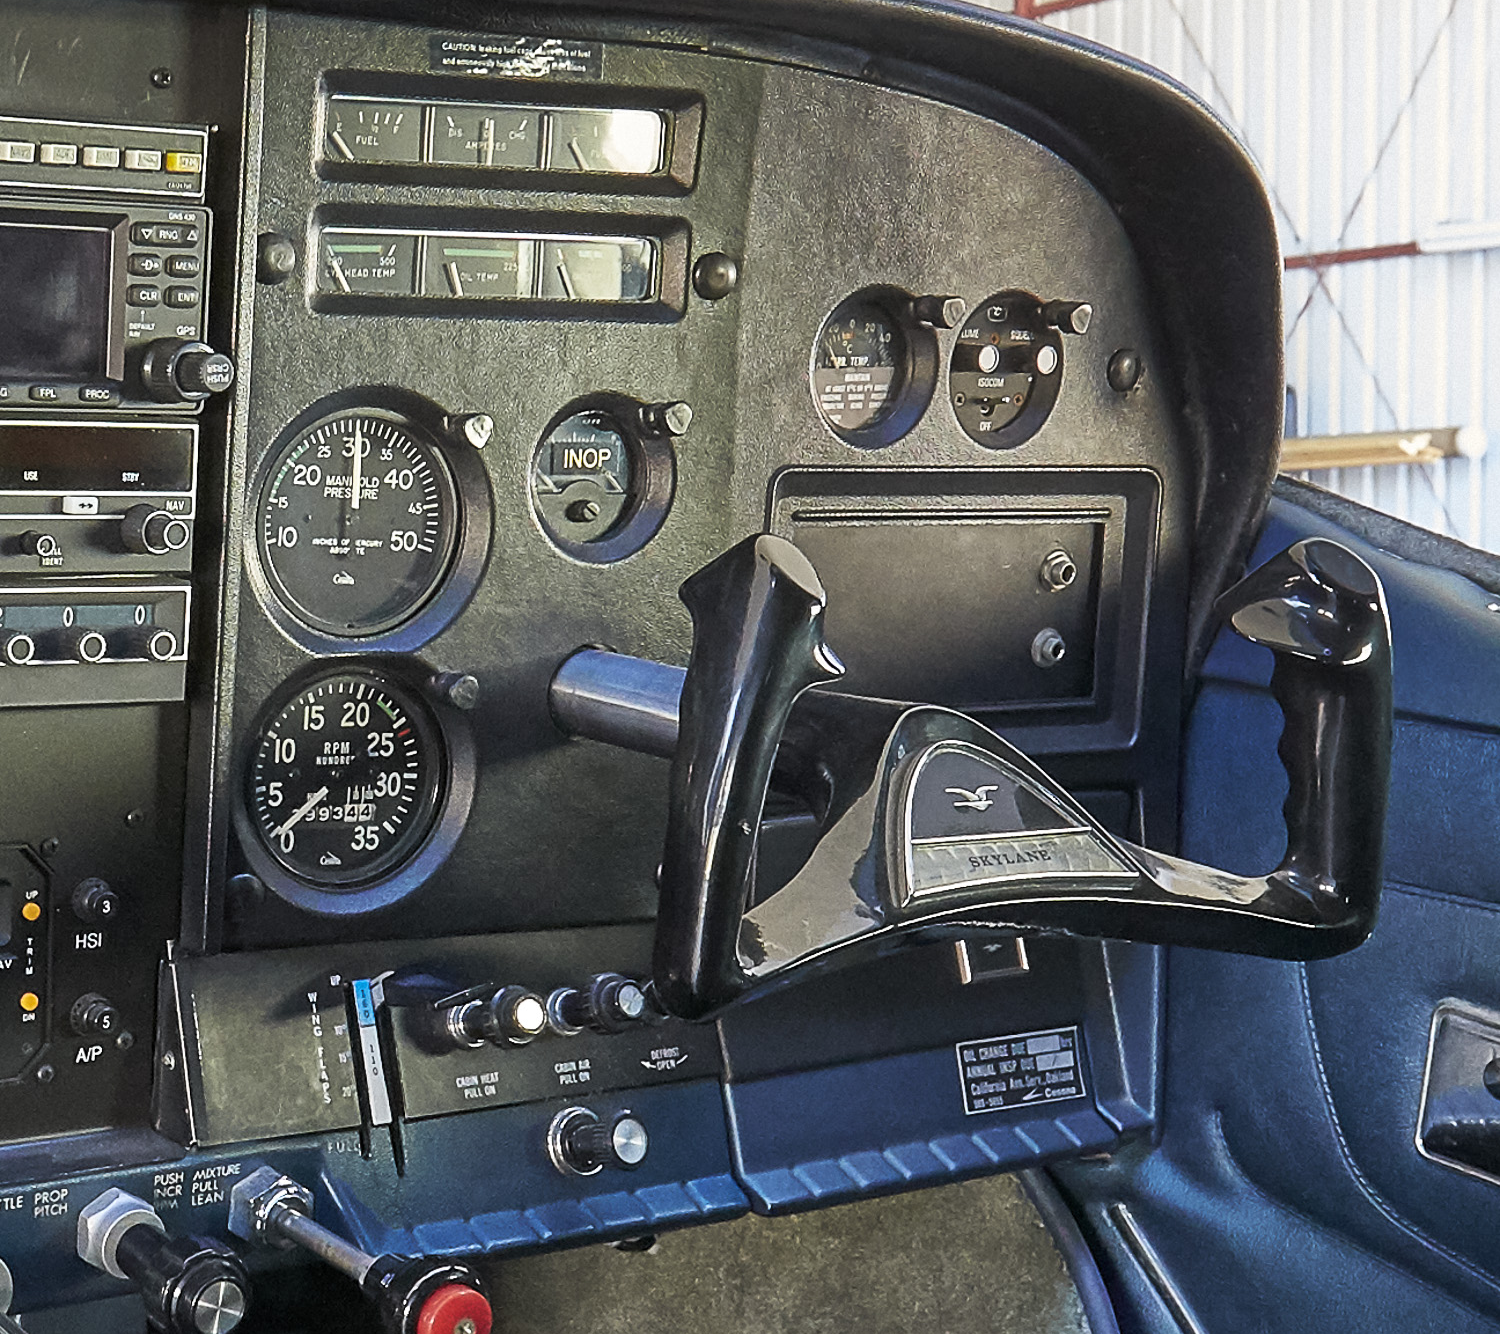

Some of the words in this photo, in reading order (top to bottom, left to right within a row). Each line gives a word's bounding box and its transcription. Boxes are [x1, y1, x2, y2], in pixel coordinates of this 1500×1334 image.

[355, 135, 379, 146] FUEL
[344, 267, 369, 278] HEAD
[371, 268, 396, 279] TEMP
[978, 377, 1004, 388] ISOCOM
[40, 388, 57, 398] FPL
[85, 389, 110, 399] PROC
[980, 421, 992, 432] OFF
[563, 448, 612, 469] INOP
[166, 500, 185, 511] NAV
[324, 742, 350, 754] RPM
[351, 825, 380, 851] 35
[968, 848, 1051, 871] SKYLANE
[75, 934, 102, 950] HSI
[75, 1046, 102, 1063] A/P
[308, 992, 323, 1037] WING
[317, 1046, 332, 1104] FLAPS
[651, 1047, 679, 1060] DEFROST
[963, 1049, 976, 1062] OIL
[978, 1044, 1008, 1060] CHANGE
[554, 1061, 577, 1074] CABIN
[578, 1059, 590, 1070] AIR
[967, 1064, 996, 1078] ANNUAL
[999, 1059, 1017, 1073] INSP
[456, 1076, 479, 1089] CABIN
[480, 1072, 499, 1083] HEAT
[580, 1072, 590, 1082] ON
[464, 1088, 483, 1099] PULL
[485, 1086, 496, 1096] ON
[971, 1081, 1007, 1096] California
[1045, 1085, 1076, 1098] Cessna
[153, 1172, 185, 1187] PUSH
[192, 1163, 241, 1181] MIXTURE
[191, 1180, 220, 1194] PULL
[34, 1189, 70, 1207] PROP
[190, 1190, 225, 1207] LEAN
[33, 1202, 69, 1219] PITCH
